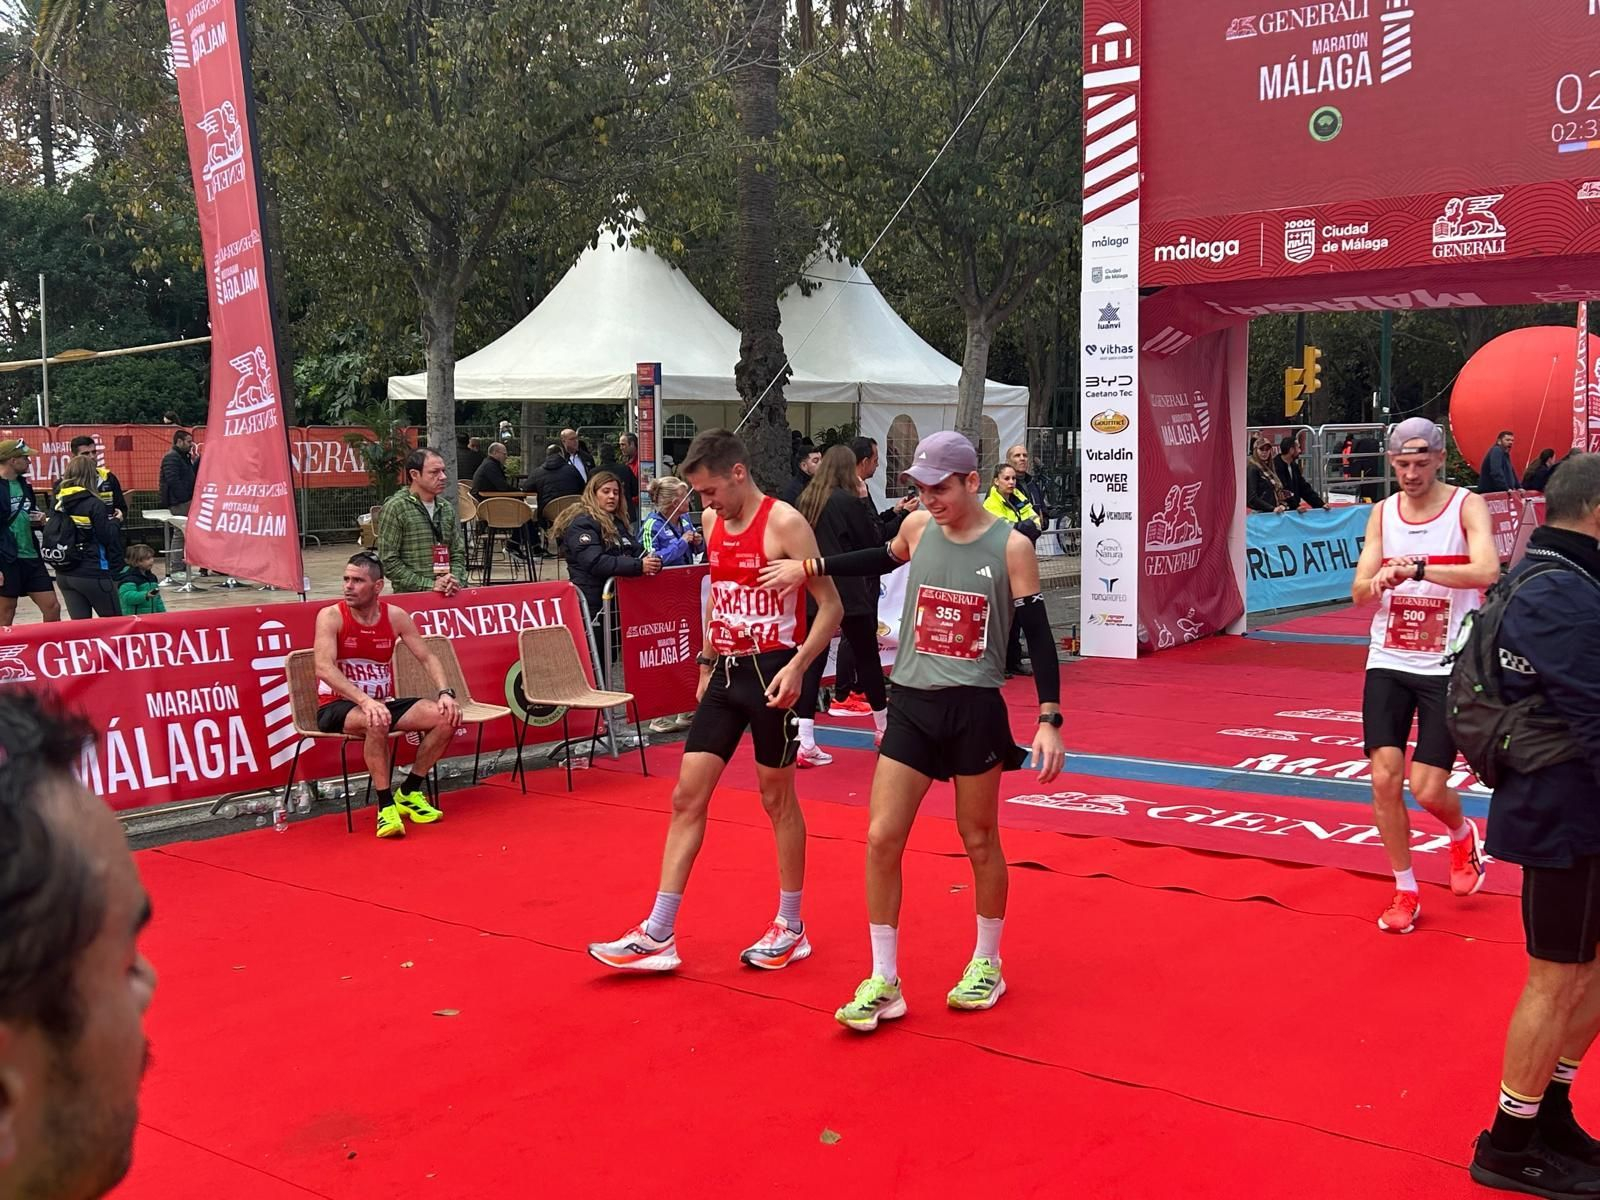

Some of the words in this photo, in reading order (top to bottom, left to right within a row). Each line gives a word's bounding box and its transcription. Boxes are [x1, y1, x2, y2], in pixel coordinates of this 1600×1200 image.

[1259, 0, 1370, 35] GENERALI
[1312, 30, 1369, 55] MARATÓN
[1260, 50, 1373, 101] MÁLAGA
[1322, 222, 1369, 238] Ciudad
[1322, 241, 1338, 253] de
[1341, 237, 1389, 252] Málaga
[1432, 239, 1507, 258] GENERALI
[1097, 321, 1121, 330] luanvi
[1100, 344, 1134, 355] vithas
[1085, 375, 1133, 388] BYD
[1085, 390, 1118, 398] Caetano
[1119, 389, 1133, 397] Tec
[1086, 448, 1133, 461] Vitaldin
[1090, 473, 1128, 483] POWER
[1107, 483, 1128, 492] ADE
[1145, 549, 1201, 576] GENERALI
[1246, 544, 1298, 581] RLD
[1302, 536, 1366, 575] ATHLE
[935, 591, 979, 606] GENERALI
[410, 597, 566, 639] GENERALI
[935, 606, 961, 621] 355
[1403, 610, 1426, 622] 500
[639, 620, 676, 637] GENERALI
[37, 627, 234, 679] GENERALI
[639, 645, 680, 669] MÁLAGA
[145, 682, 240, 718] MARATÓN
